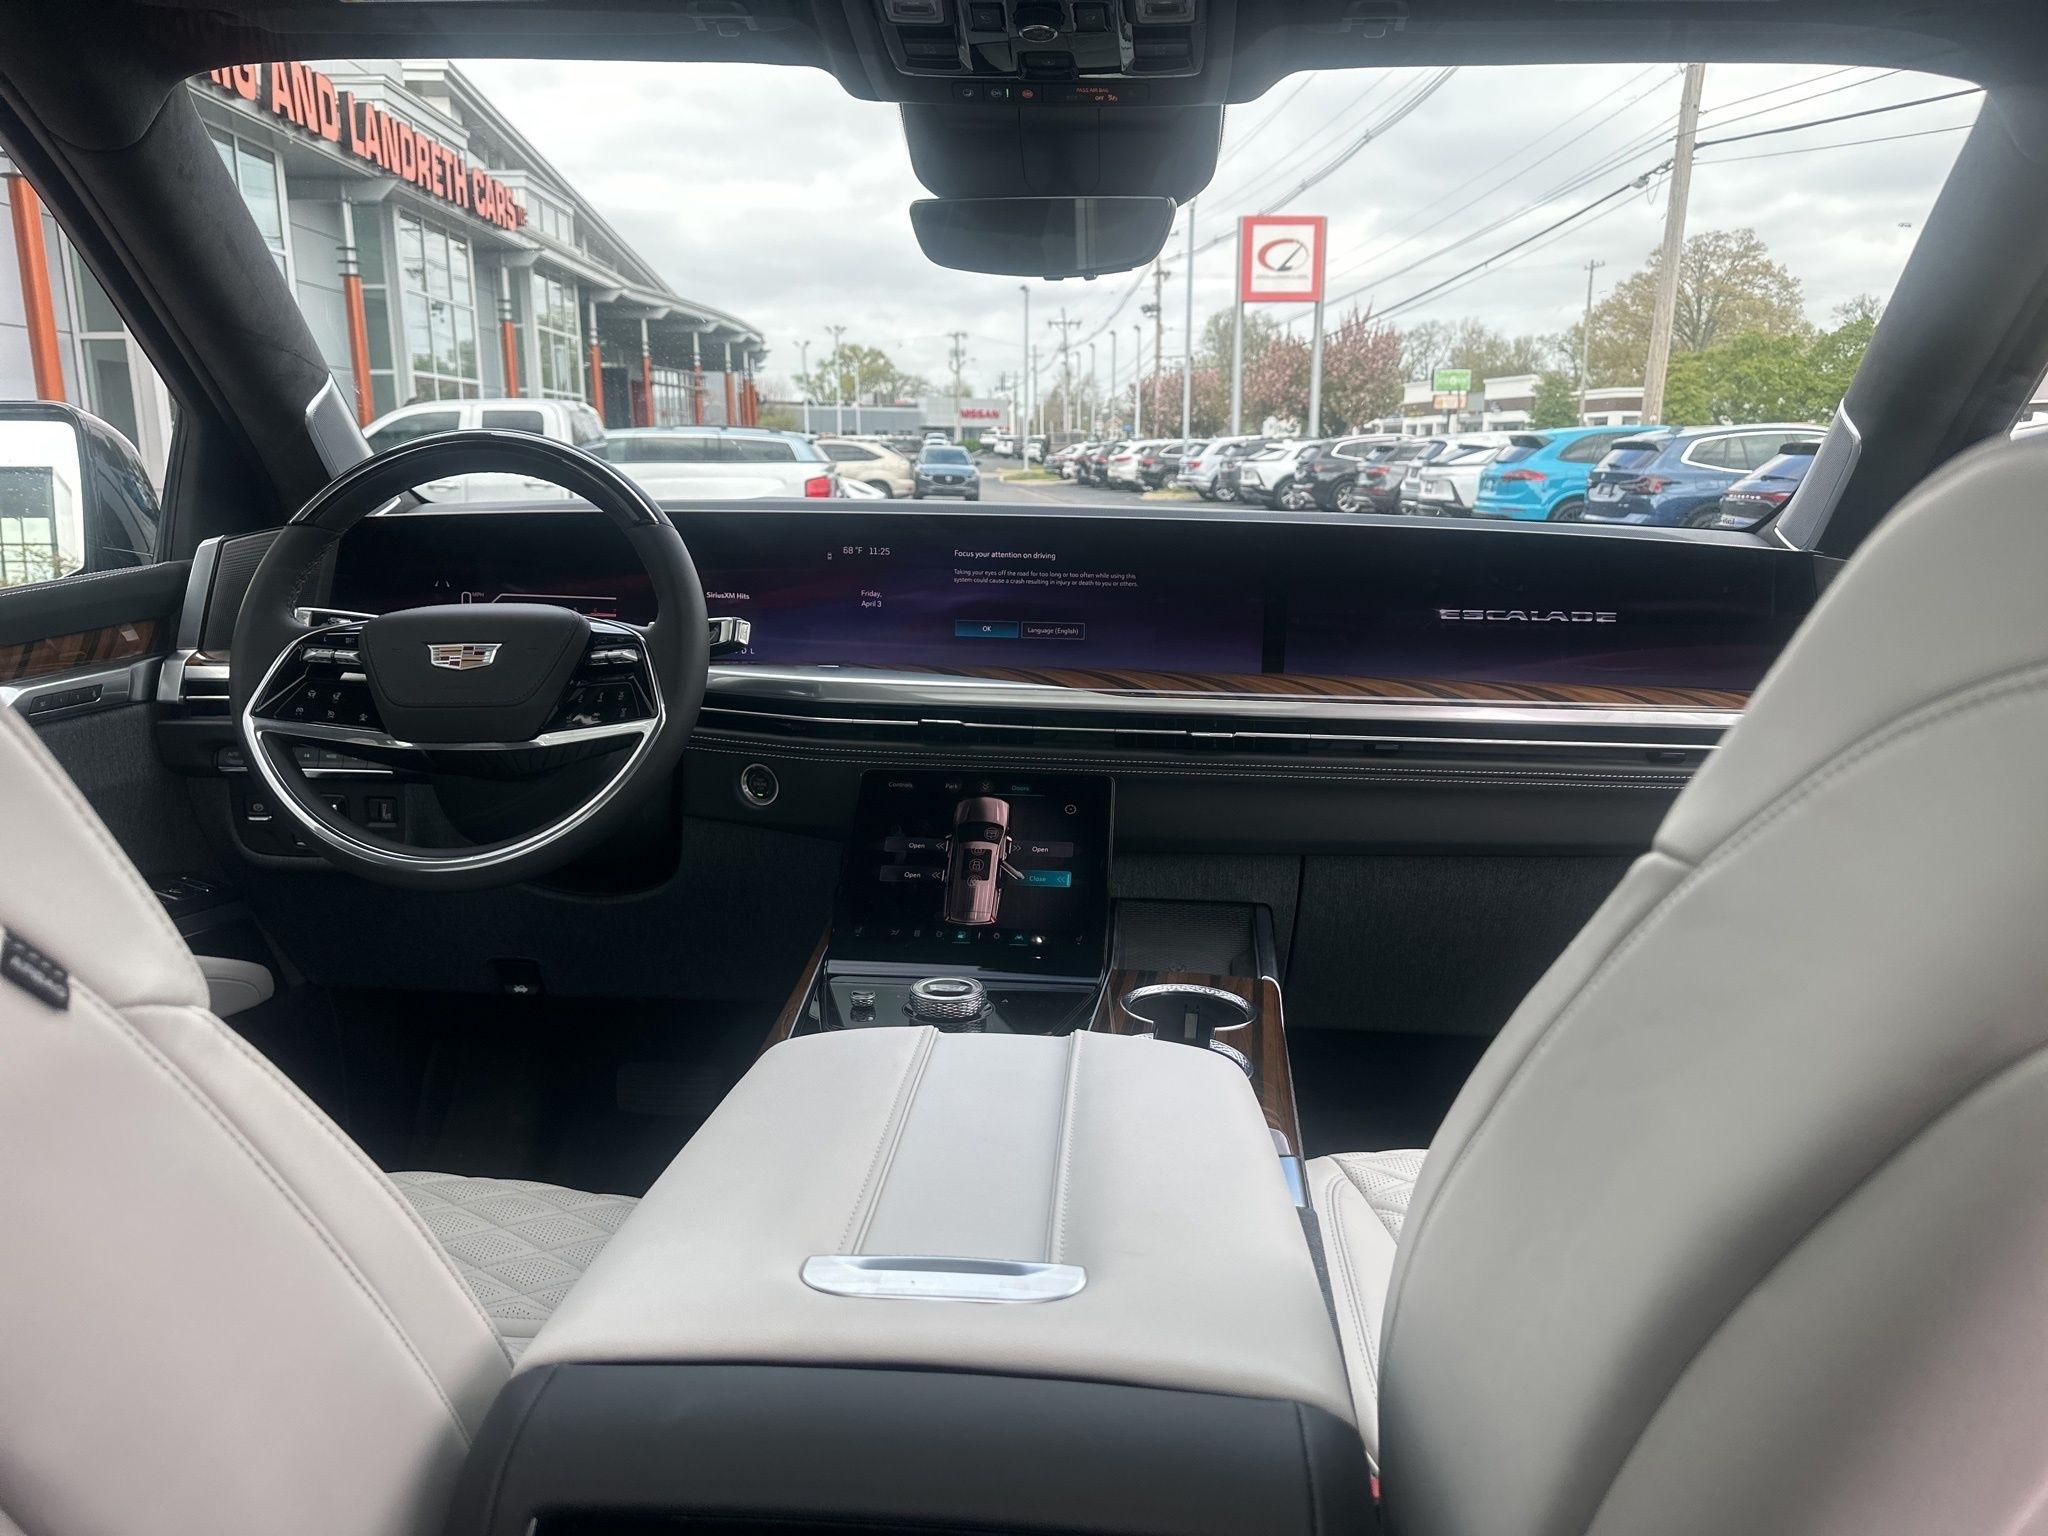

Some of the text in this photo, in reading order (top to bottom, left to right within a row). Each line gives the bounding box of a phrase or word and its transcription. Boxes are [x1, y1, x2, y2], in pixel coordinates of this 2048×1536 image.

[271, 61, 340, 142] AND
[347, 92, 469, 208] LANDRETH
[473, 168, 517, 231] CARS
[960, 408, 1000, 419] NISSAN
[869, 547, 891, 556] 11:25
[954, 549, 974, 558] Focus
[975, 551, 990, 559] your
[991, 551, 1022, 559] attention
[1033, 552, 1056, 561] driving
[954, 568, 972, 577] Taking
[706, 591, 750, 600] SiriusXM Hits
[860, 590, 883, 599] Friday,
[861, 600, 882, 609] April 3
[1438, 609, 1618, 623] ESCALADE
[982, 624, 992, 633] OK
[1027, 627, 1079, 636] Language (English)
[888, 781, 914, 789] Controls
[1011, 784, 1030, 792] Doors
[908, 842, 926, 850] Open
[1031, 846, 1050, 854] Open
[903, 872, 922, 880] Open
